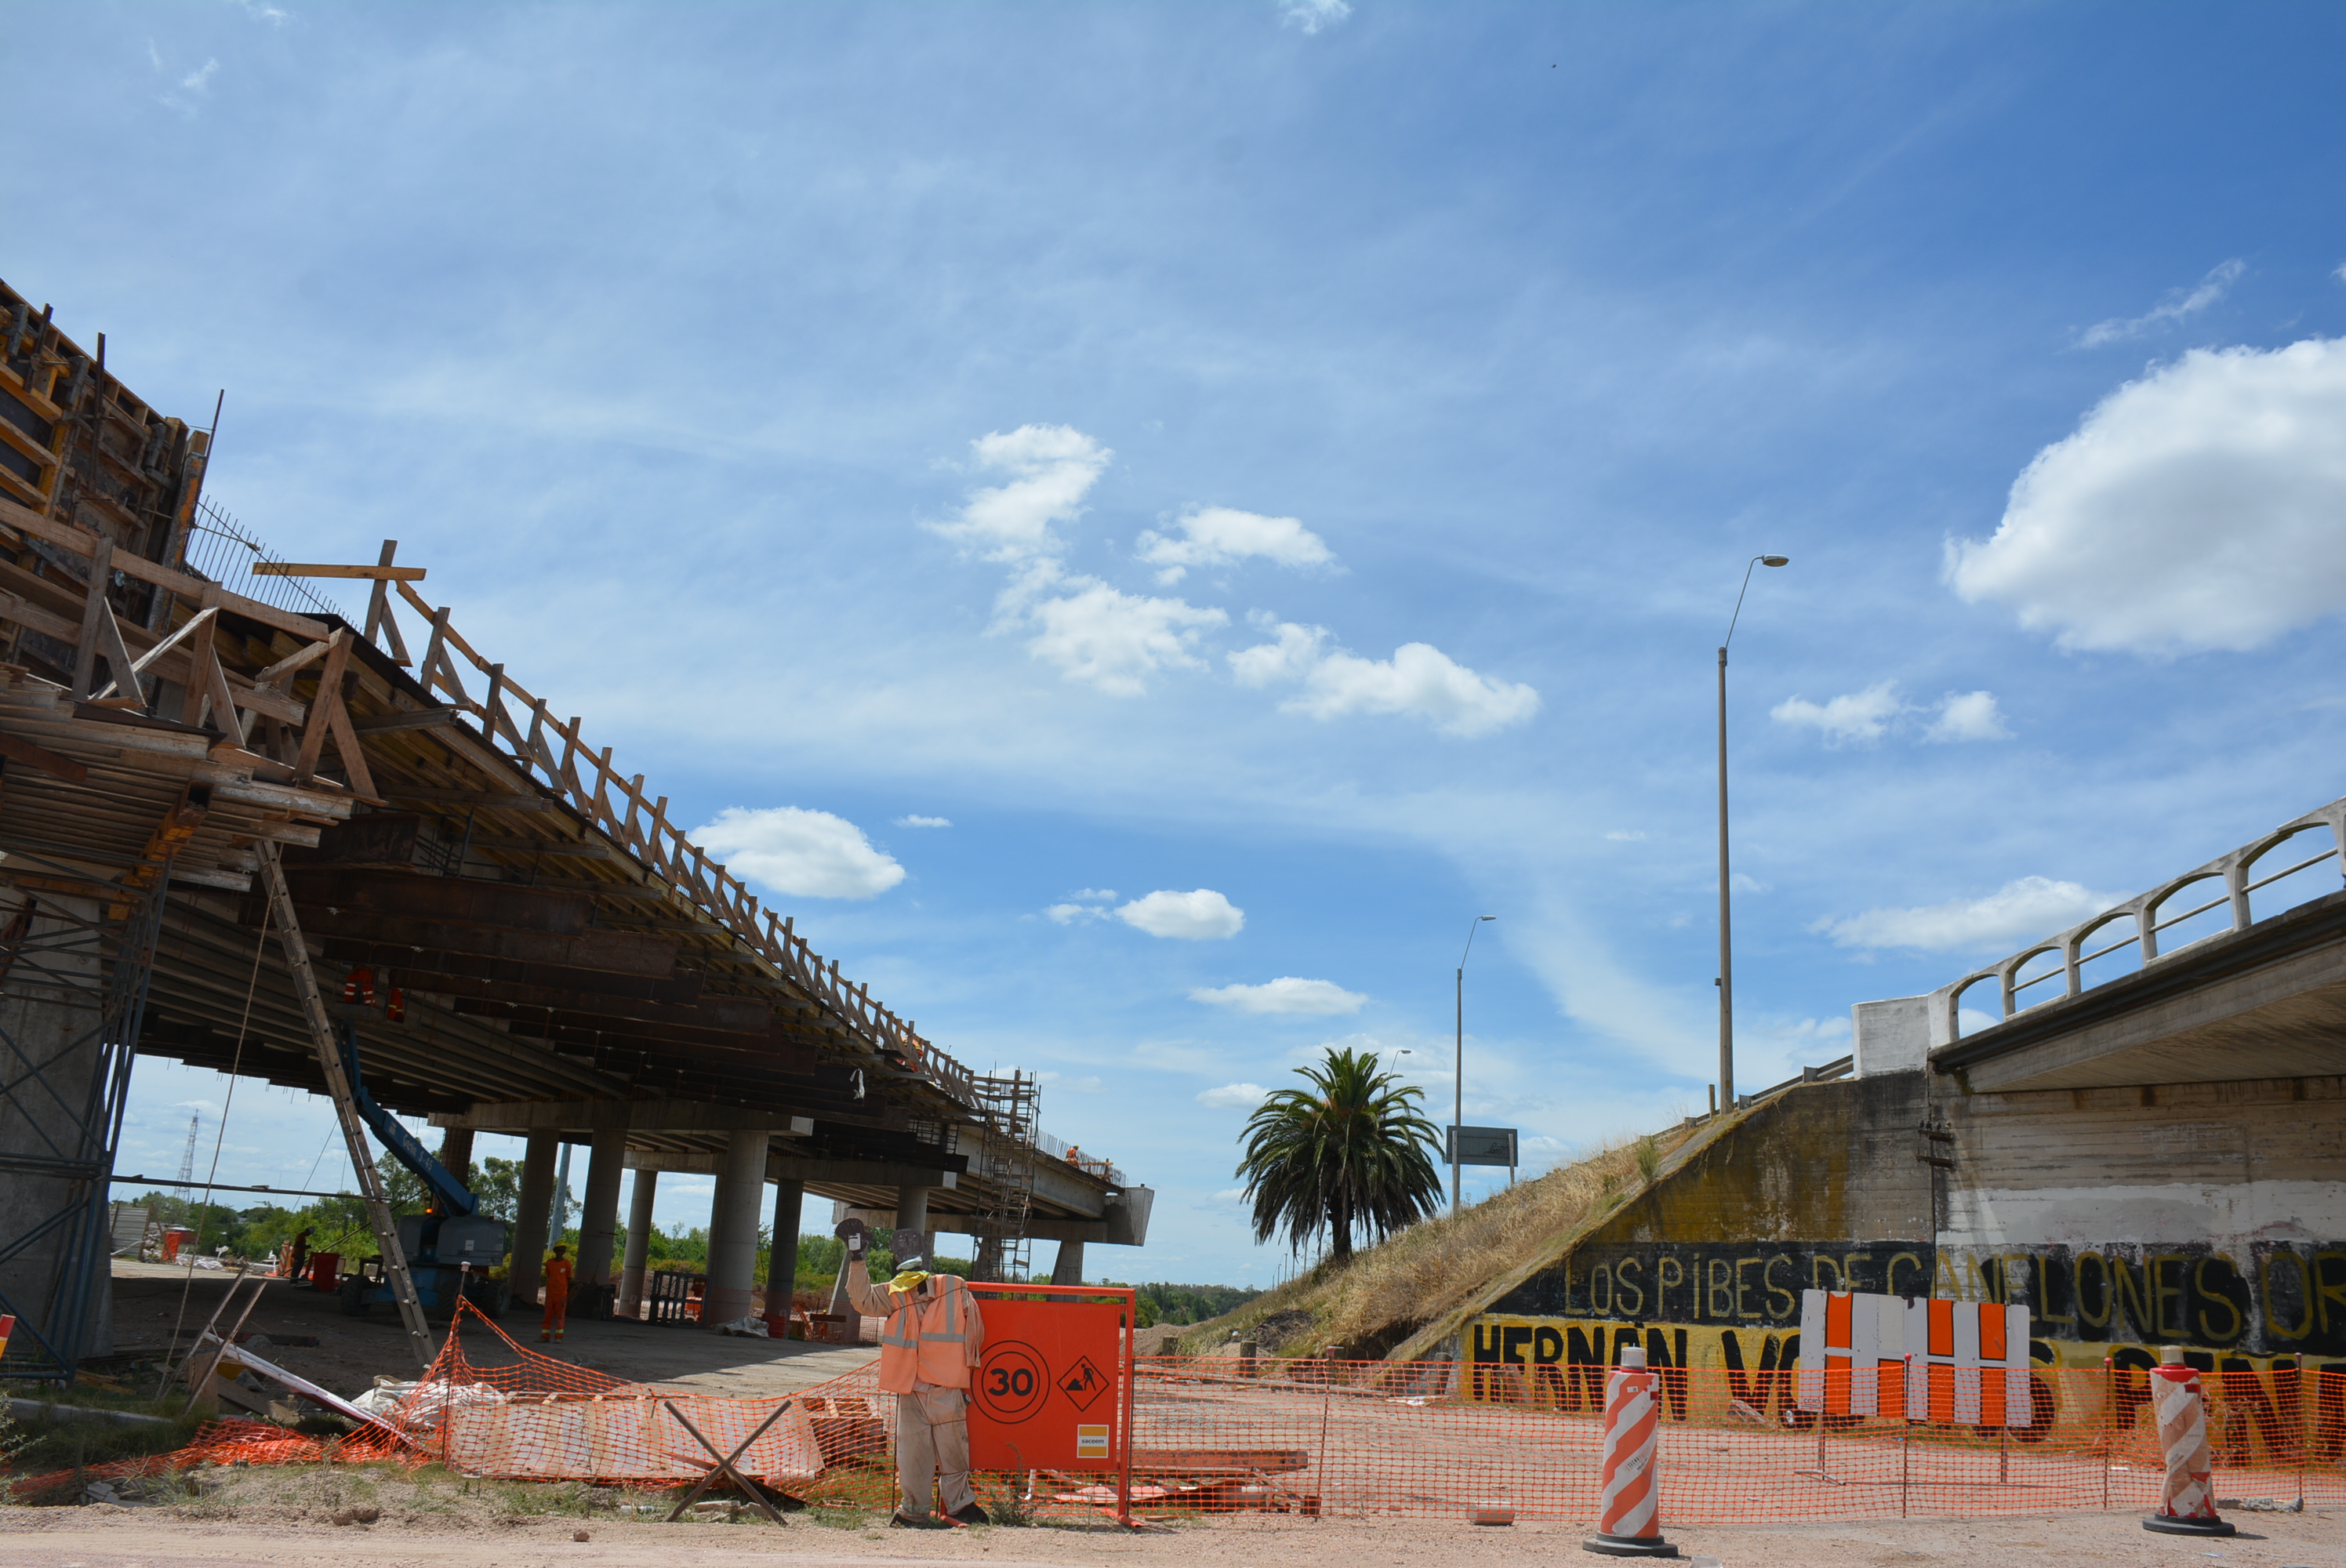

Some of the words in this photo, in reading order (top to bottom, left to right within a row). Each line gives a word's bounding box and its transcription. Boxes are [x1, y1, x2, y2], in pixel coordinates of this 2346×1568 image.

[419, 1151, 434, 1171] S-45
[1565, 1256, 1644, 1316] LOS
[988, 1368, 1033, 1396] 30
